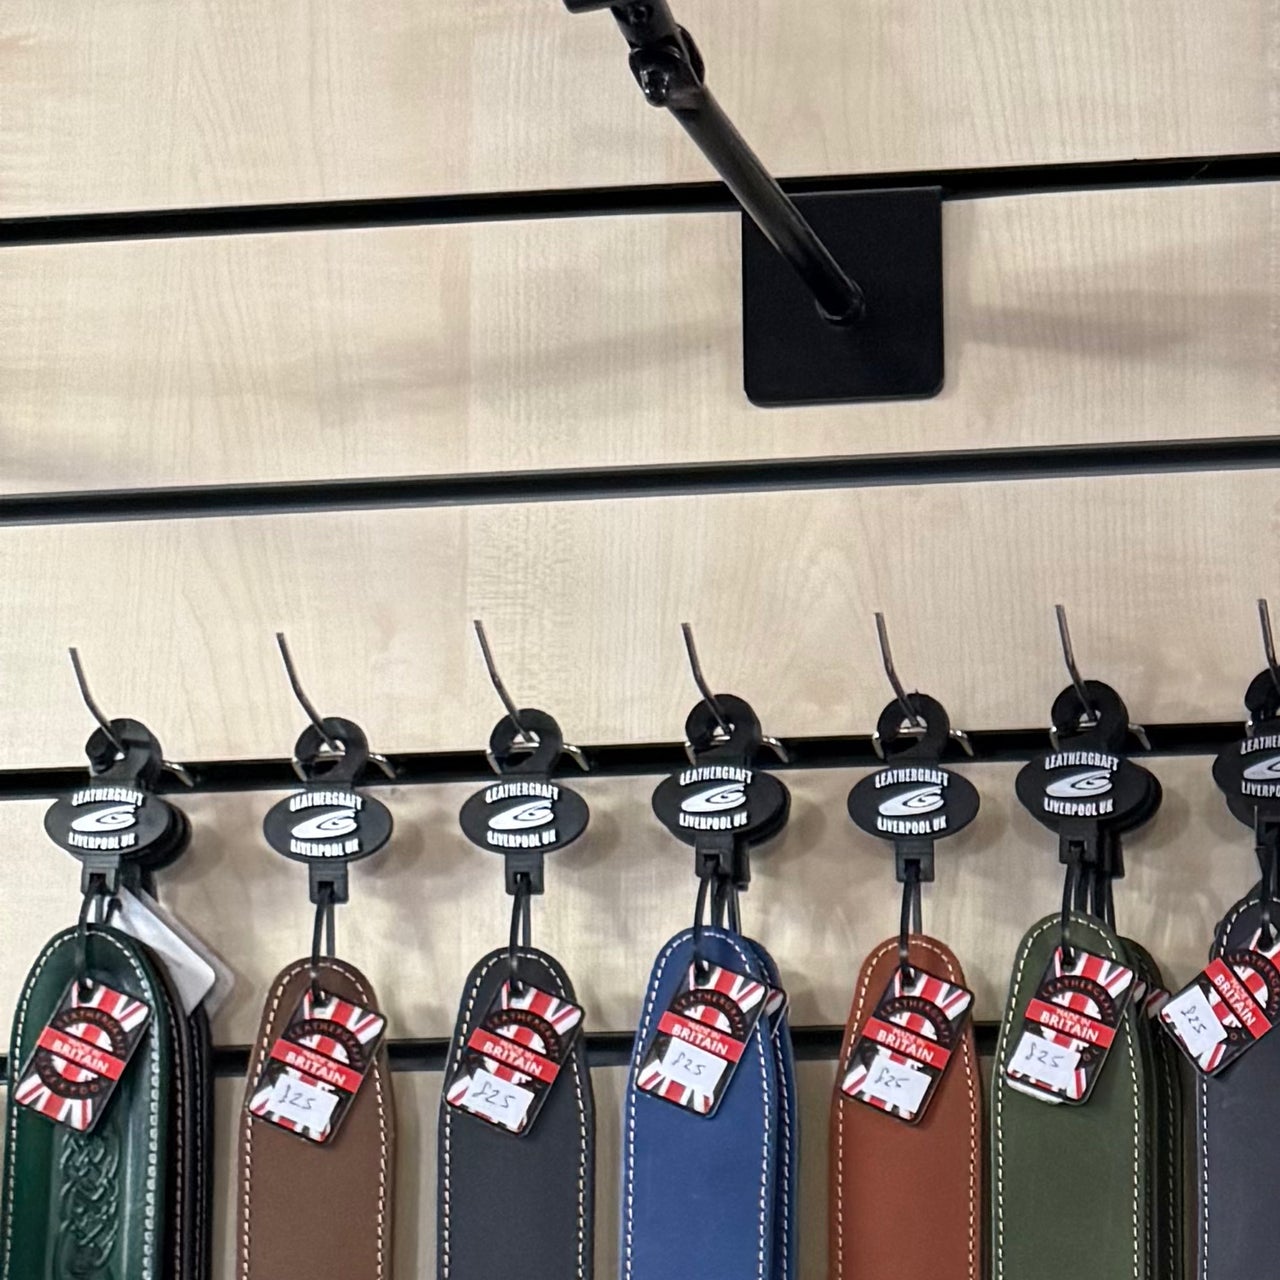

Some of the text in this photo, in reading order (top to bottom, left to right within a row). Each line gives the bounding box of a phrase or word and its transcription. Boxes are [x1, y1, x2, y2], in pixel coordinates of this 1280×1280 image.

[678, 810, 748, 830] LIVERPOOL UK
[1043, 797, 1114, 817] LIVERPOOL UK
[68, 831, 136, 850] LIVERPOOL UK
[486, 829, 557, 848] LIVERPOOL UK
[876, 815, 947, 834] LIVERPOOL UK
[290, 837, 360, 857] LIVERPOOL UK
[1214, 974, 1257, 1025] BRITAIN
[672, 1023, 729, 1055] BRITAIN
[1039, 1011, 1099, 1043] BRITAIN
[52, 1039, 109, 1071] BRITAIN
[483, 1041, 543, 1075] BRITAIN
[877, 1029, 934, 1063] BRITAIN
[286, 1051, 346, 1086] BRITAIN
